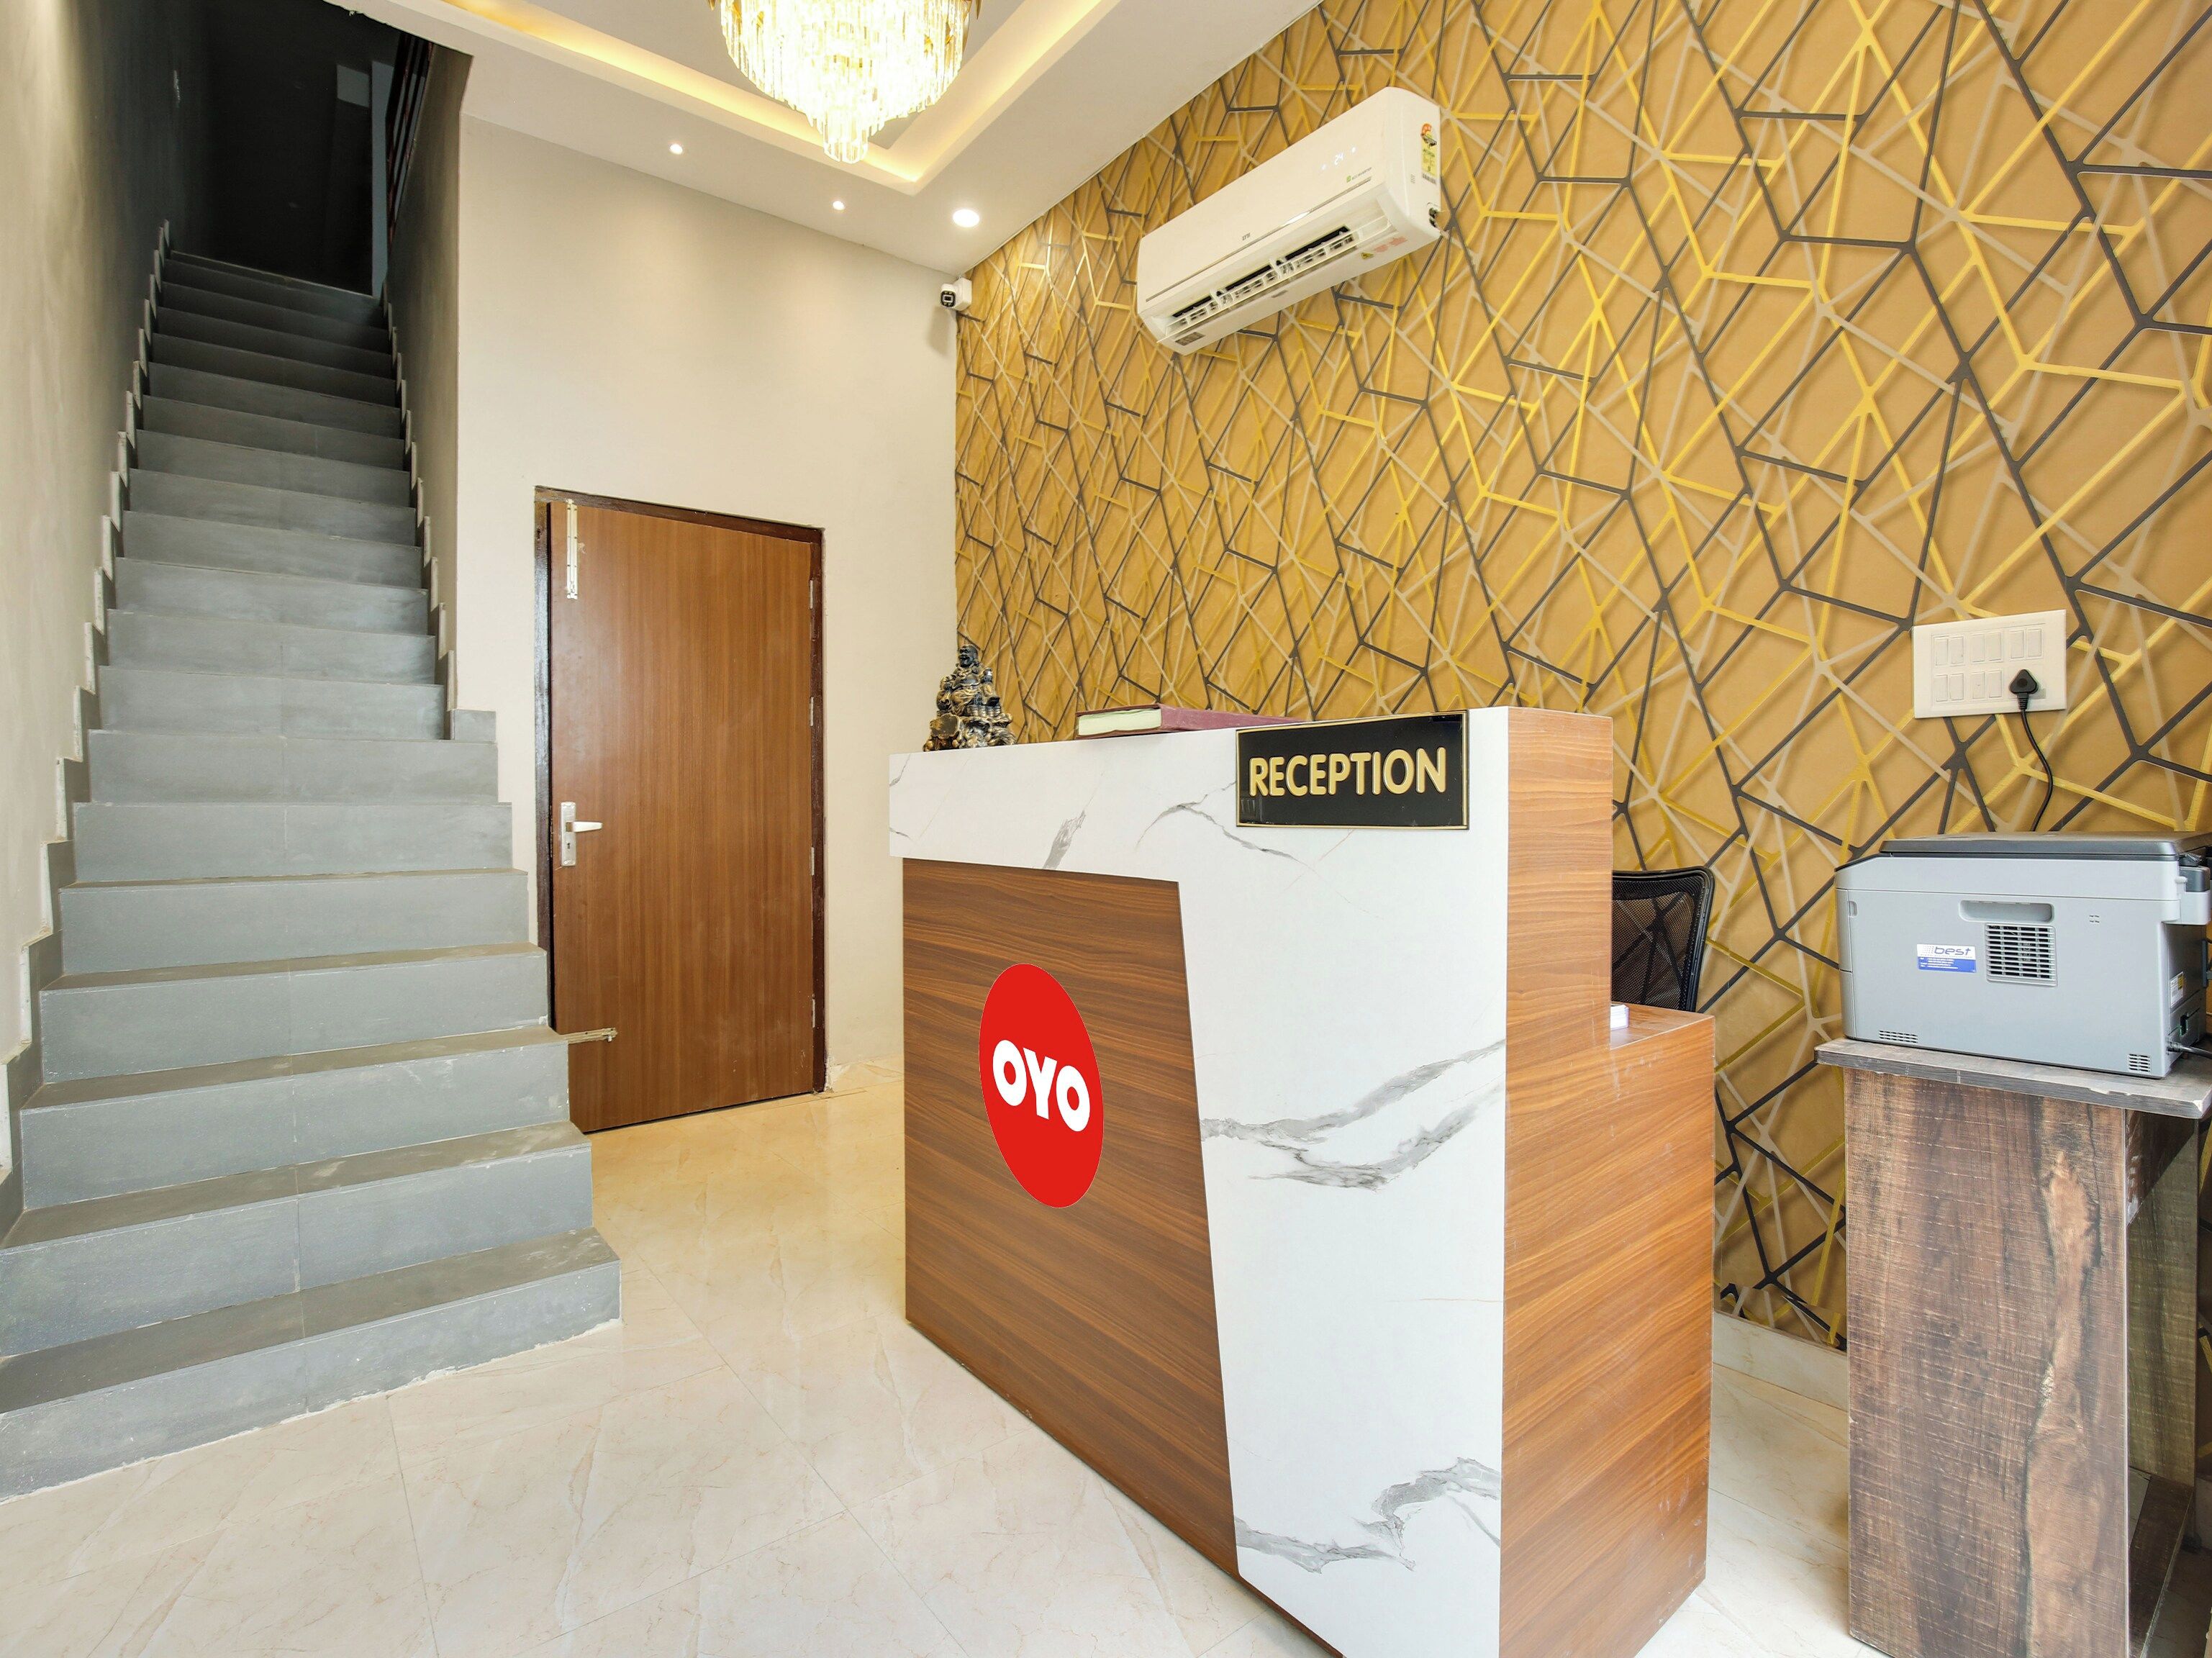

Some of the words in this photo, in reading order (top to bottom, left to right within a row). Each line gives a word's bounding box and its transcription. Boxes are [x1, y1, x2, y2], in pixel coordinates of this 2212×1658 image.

[1249, 746, 1446, 797] RECEPTION
[1934, 946, 1972, 956] best
[992, 1039, 1091, 1132] OYO
